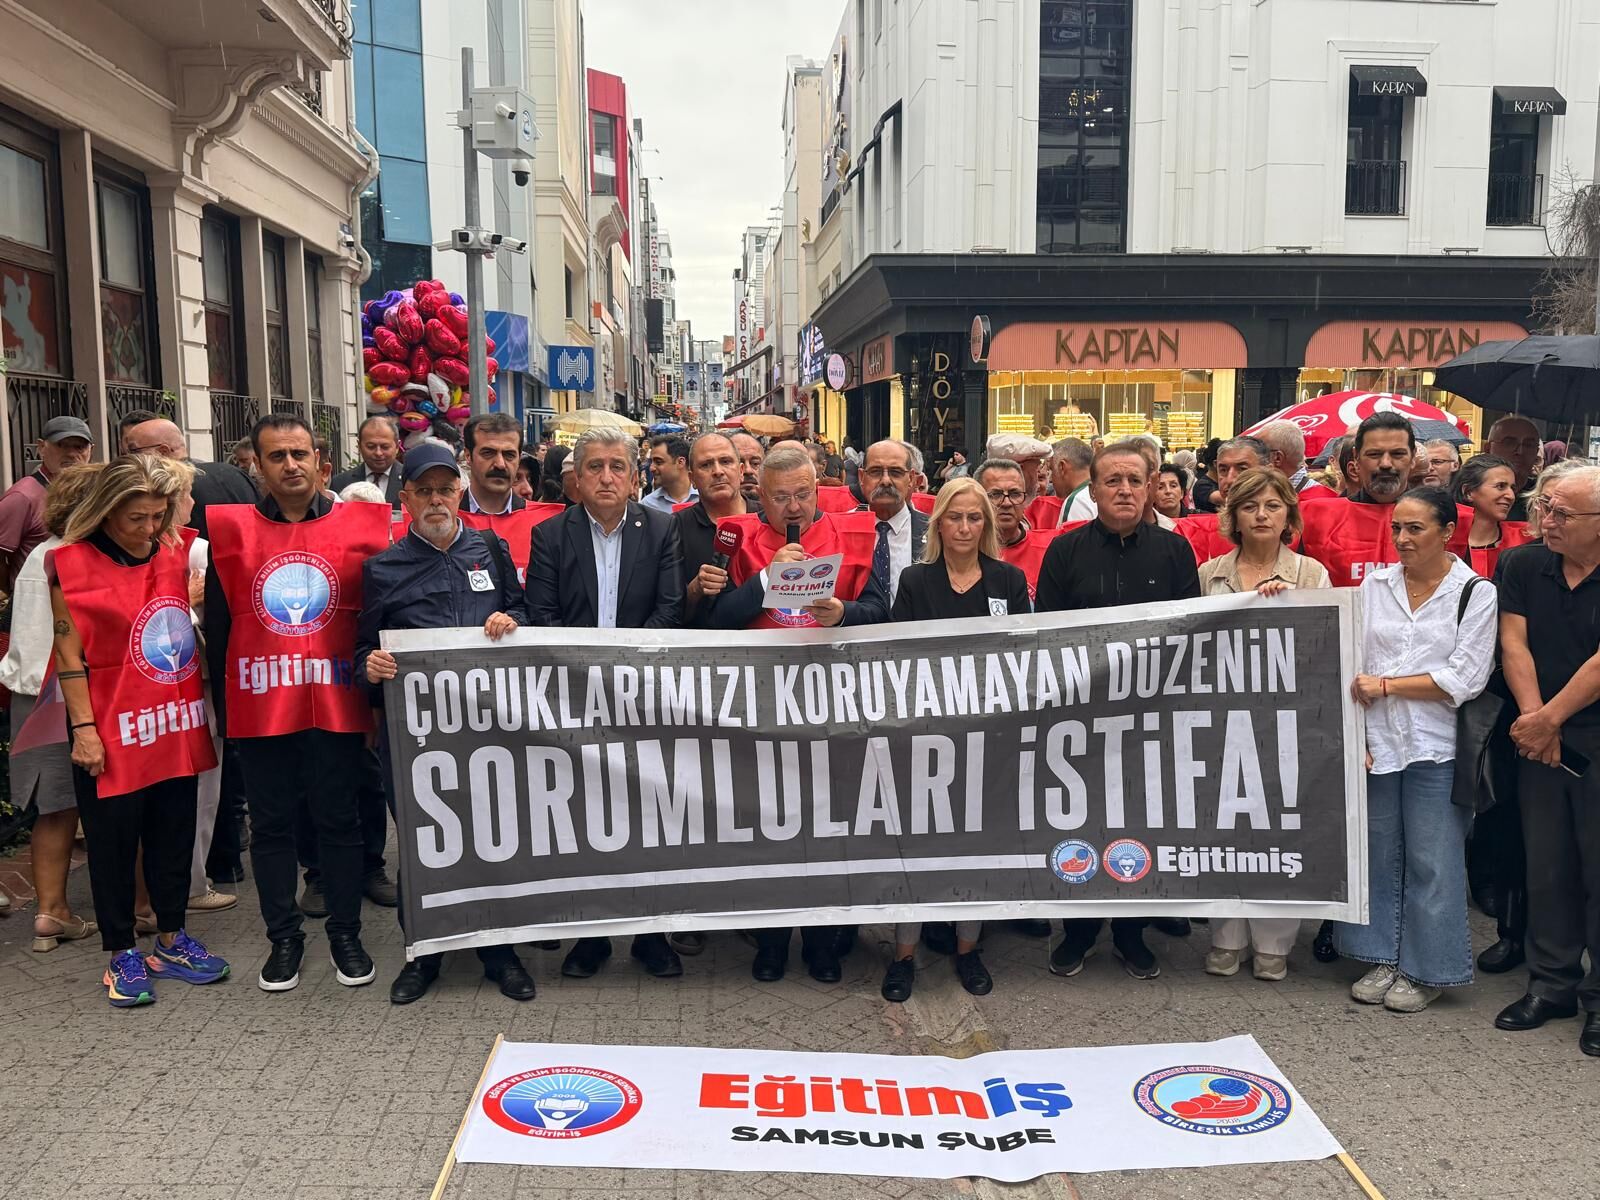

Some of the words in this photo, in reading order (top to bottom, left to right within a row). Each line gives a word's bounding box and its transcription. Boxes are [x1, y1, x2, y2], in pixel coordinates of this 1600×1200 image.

[1373, 80, 1415, 94] KAPTAN
[1514, 100, 1554, 113] KAPTAN
[740, 300, 748, 331] AKSU
[1056, 328, 1179, 364] KAPTAN
[1362, 328, 1480, 362] KAPTAN
[932, 352, 952, 479] DÖVİZ
[261, 561, 279, 579] BİLİM
[280, 554, 332, 575] İŞGÖRENLERİ
[255, 580, 263, 589] VE
[326, 575, 337, 616] SENDİKASI
[255, 591, 266, 618] EĞİTİM
[136, 610, 151, 630] BİLİM
[134, 633, 140, 643] VE
[403, 665, 757, 747] ÇOCUKLARIMIZI
[773, 645, 1092, 726] KORUYAMAYAN
[1106, 627, 1296, 702] DÜZENİN
[411, 731, 985, 869] SORUMLULARI
[1018, 709, 1301, 831] İSTİFA!
[1156, 845, 1303, 879] Eğitimiş
[488, 1080, 511, 1098] EĞİTİM
[509, 1075, 523, 1083] VE
[521, 1069, 550, 1080] BİLİM
[551, 1067, 619, 1080] İŞGÖRENLERİ
[699, 1073, 1073, 1119] Eğitimiş
[527, 1128, 582, 1137] EĞİTİM-İŞ
[1163, 1115, 1233, 1134] BİRLEŞİK
[1236, 1109, 1287, 1133] KAMU-İŞ
[730, 1126, 924, 1149] SAMSUN
[937, 1128, 1056, 1152] ŞUBE
